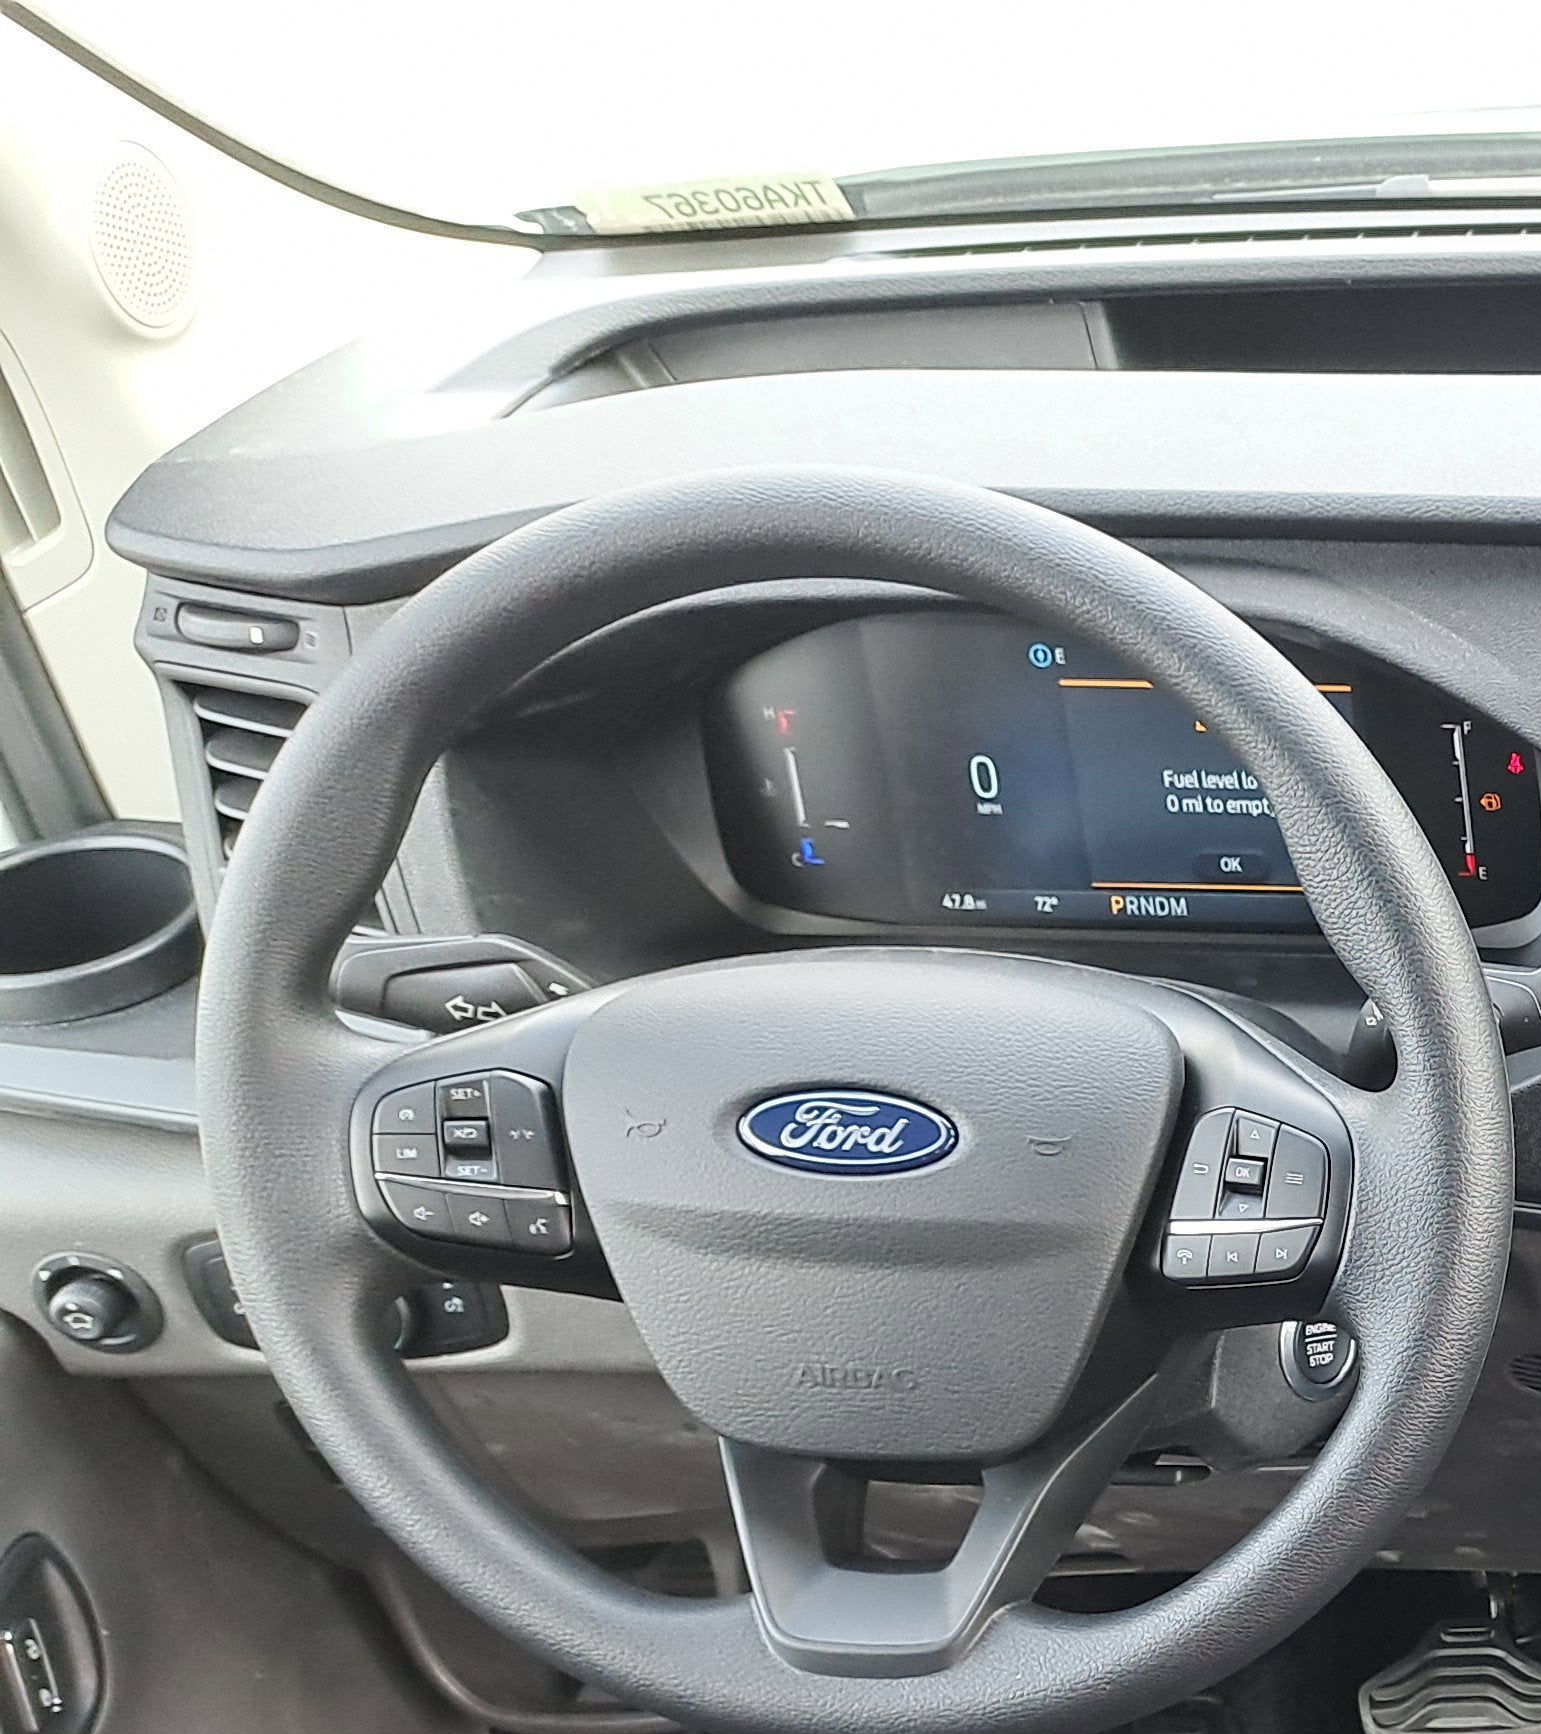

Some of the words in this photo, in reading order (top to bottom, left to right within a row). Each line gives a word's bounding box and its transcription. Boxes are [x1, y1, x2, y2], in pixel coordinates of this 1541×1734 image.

[968, 753, 999, 800] 0
[1162, 769, 1197, 789] Fuel
[1201, 770, 1238, 790] level
[1241, 771, 1259, 790] lo
[1166, 794, 1176, 813] 0
[1206, 797, 1224, 814] to
[1219, 855, 1243, 873] OK
[1478, 866, 1488, 881] E
[1109, 895, 1189, 917] PRNDM
[779, 1101, 911, 1154] Ford
[1235, 1166, 1251, 1179] OK
[1306, 1340, 1336, 1355] START
[1308, 1352, 1335, 1368] STOP
